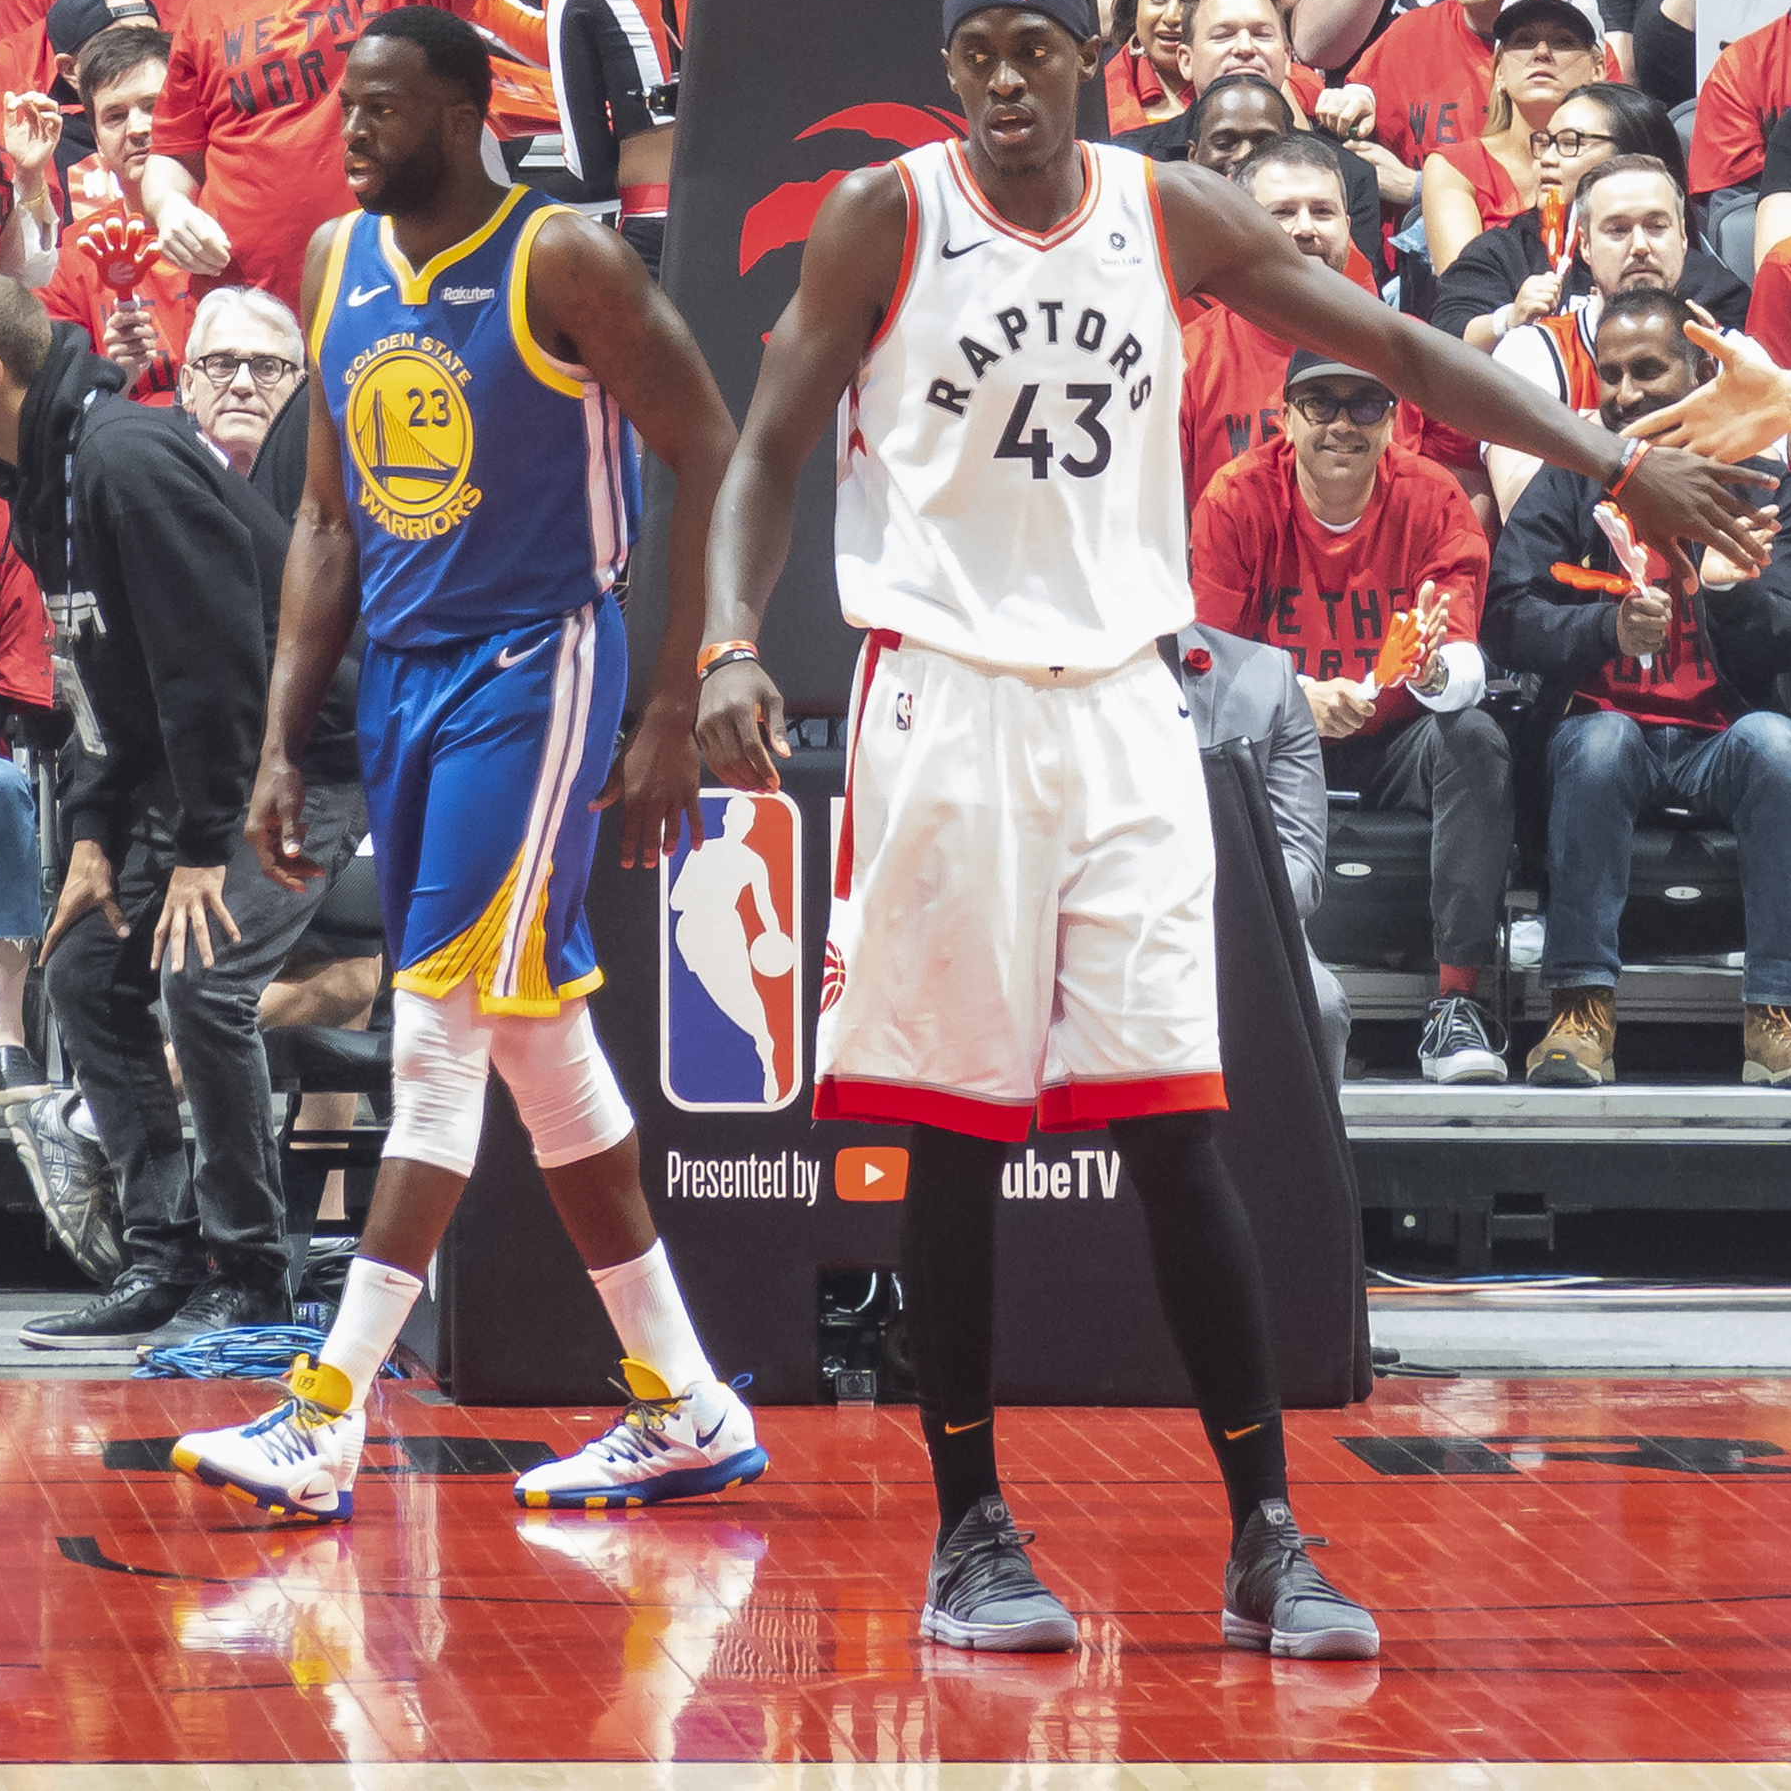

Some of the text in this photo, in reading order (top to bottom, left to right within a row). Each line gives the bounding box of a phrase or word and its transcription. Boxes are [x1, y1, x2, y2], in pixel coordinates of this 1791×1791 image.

[222, 26, 276, 68] WE
[1409, 101, 1459, 145] WE
[443, 286, 495, 301] Rakuten
[343, 330, 473, 388] GOLDEN STATE
[925, 299, 1153, 418] RAPTORS
[407, 388, 453, 428] 23
[993, 381, 1114, 480] 43
[355, 480, 484, 542] WARRIORS
[666, 1151, 788, 1200] Presented
[793, 1151, 821, 1207] by
